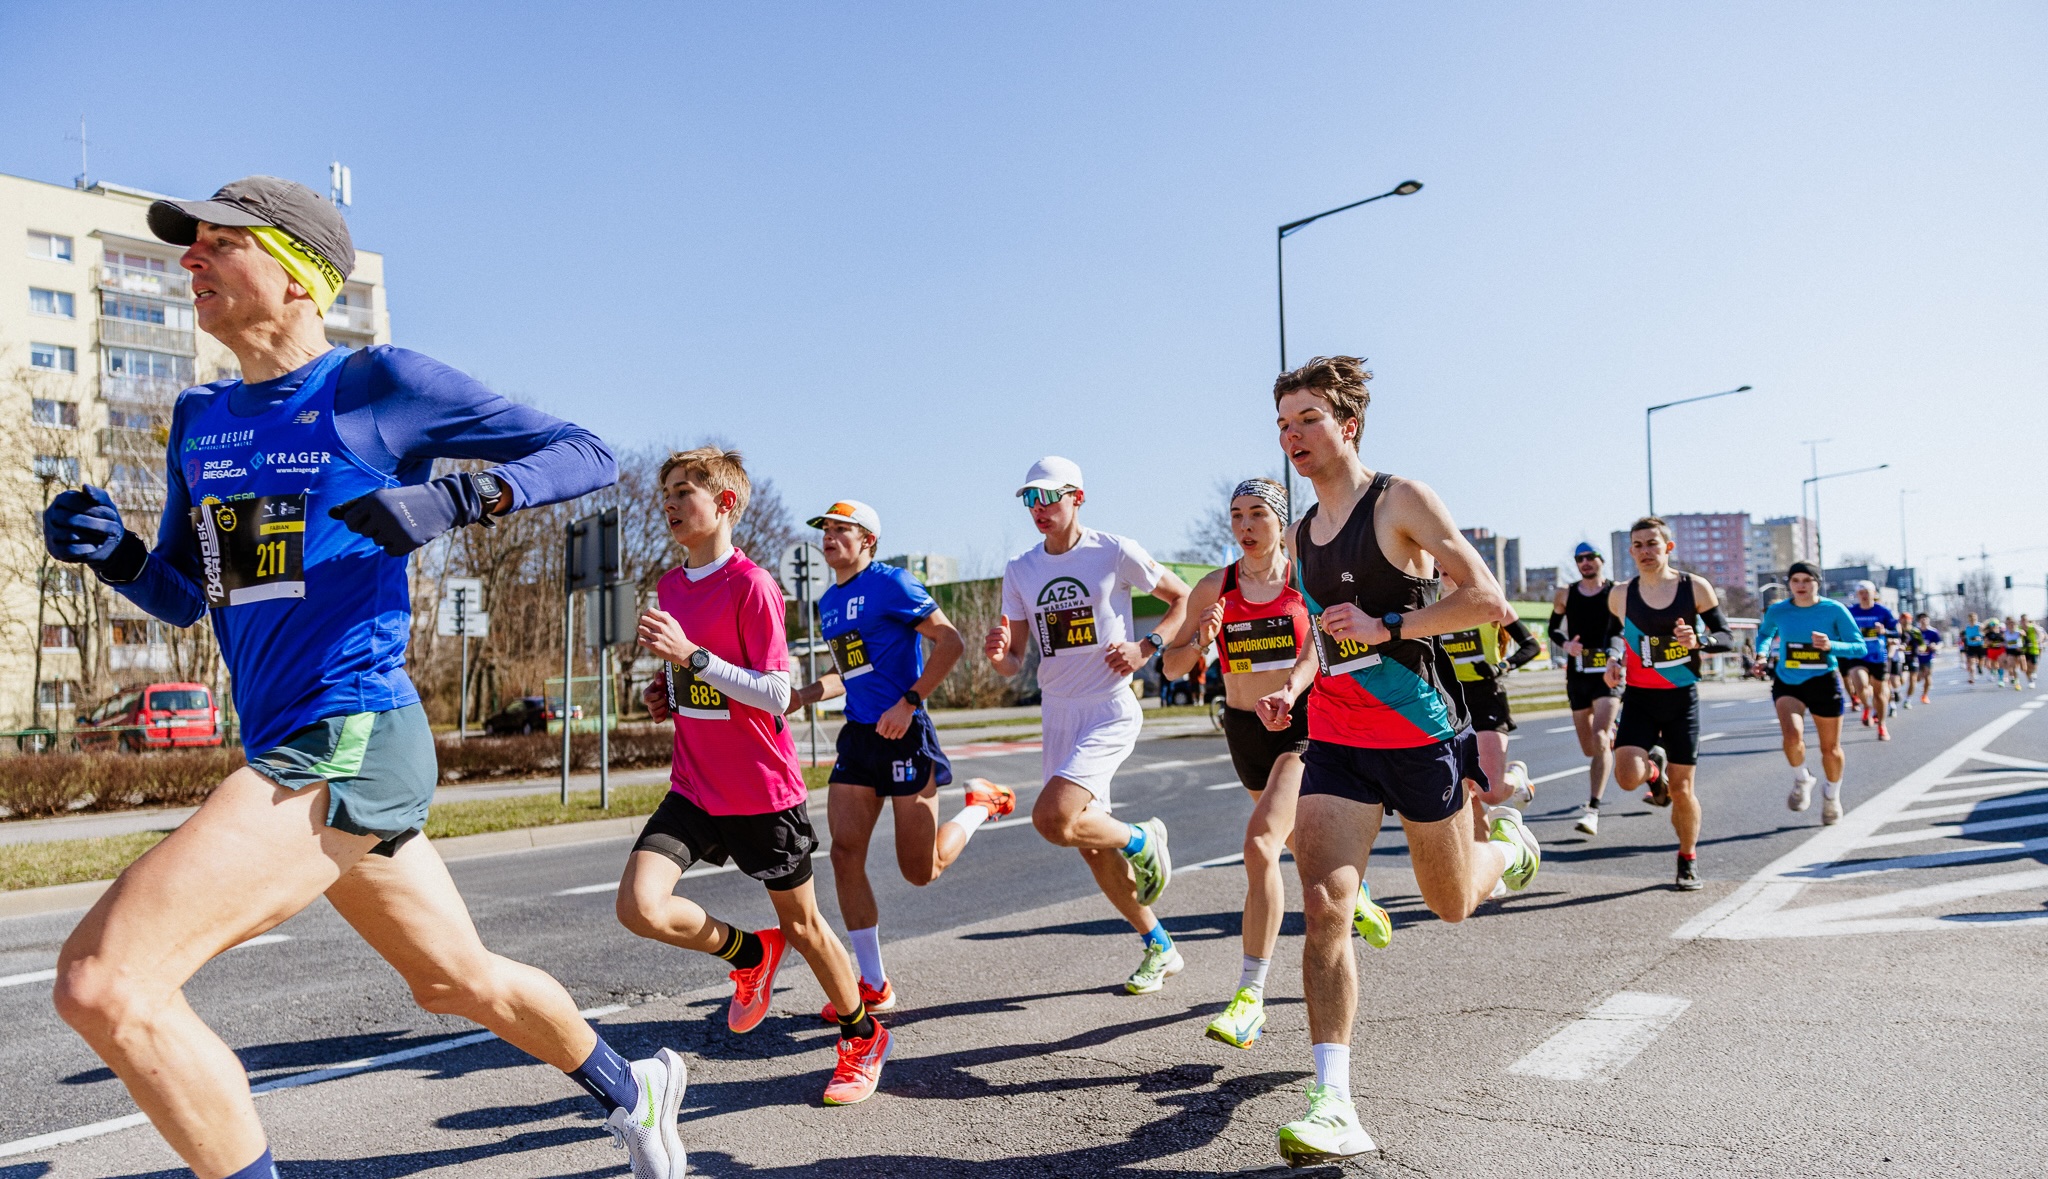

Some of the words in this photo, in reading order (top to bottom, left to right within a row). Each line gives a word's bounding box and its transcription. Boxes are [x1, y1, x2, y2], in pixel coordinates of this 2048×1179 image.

[221, 429, 255, 443] DESIGN
[203, 459, 234, 470] SKLEP
[266, 451, 331, 465] KRAGER
[203, 468, 248, 480] BIEGACZA
[275, 466, 320, 474] www.krager.pl
[256, 540, 286, 578] 211
[1047, 585, 1077, 604] AZS
[1043, 599, 1085, 612] WARSZAWA
[1067, 626, 1093, 645] 444
[1227, 635, 1294, 653] NAPIÓRKOWSKA
[847, 649, 864, 668] 470
[1236, 661, 1249, 671] 698
[690, 684, 721, 706] 885
